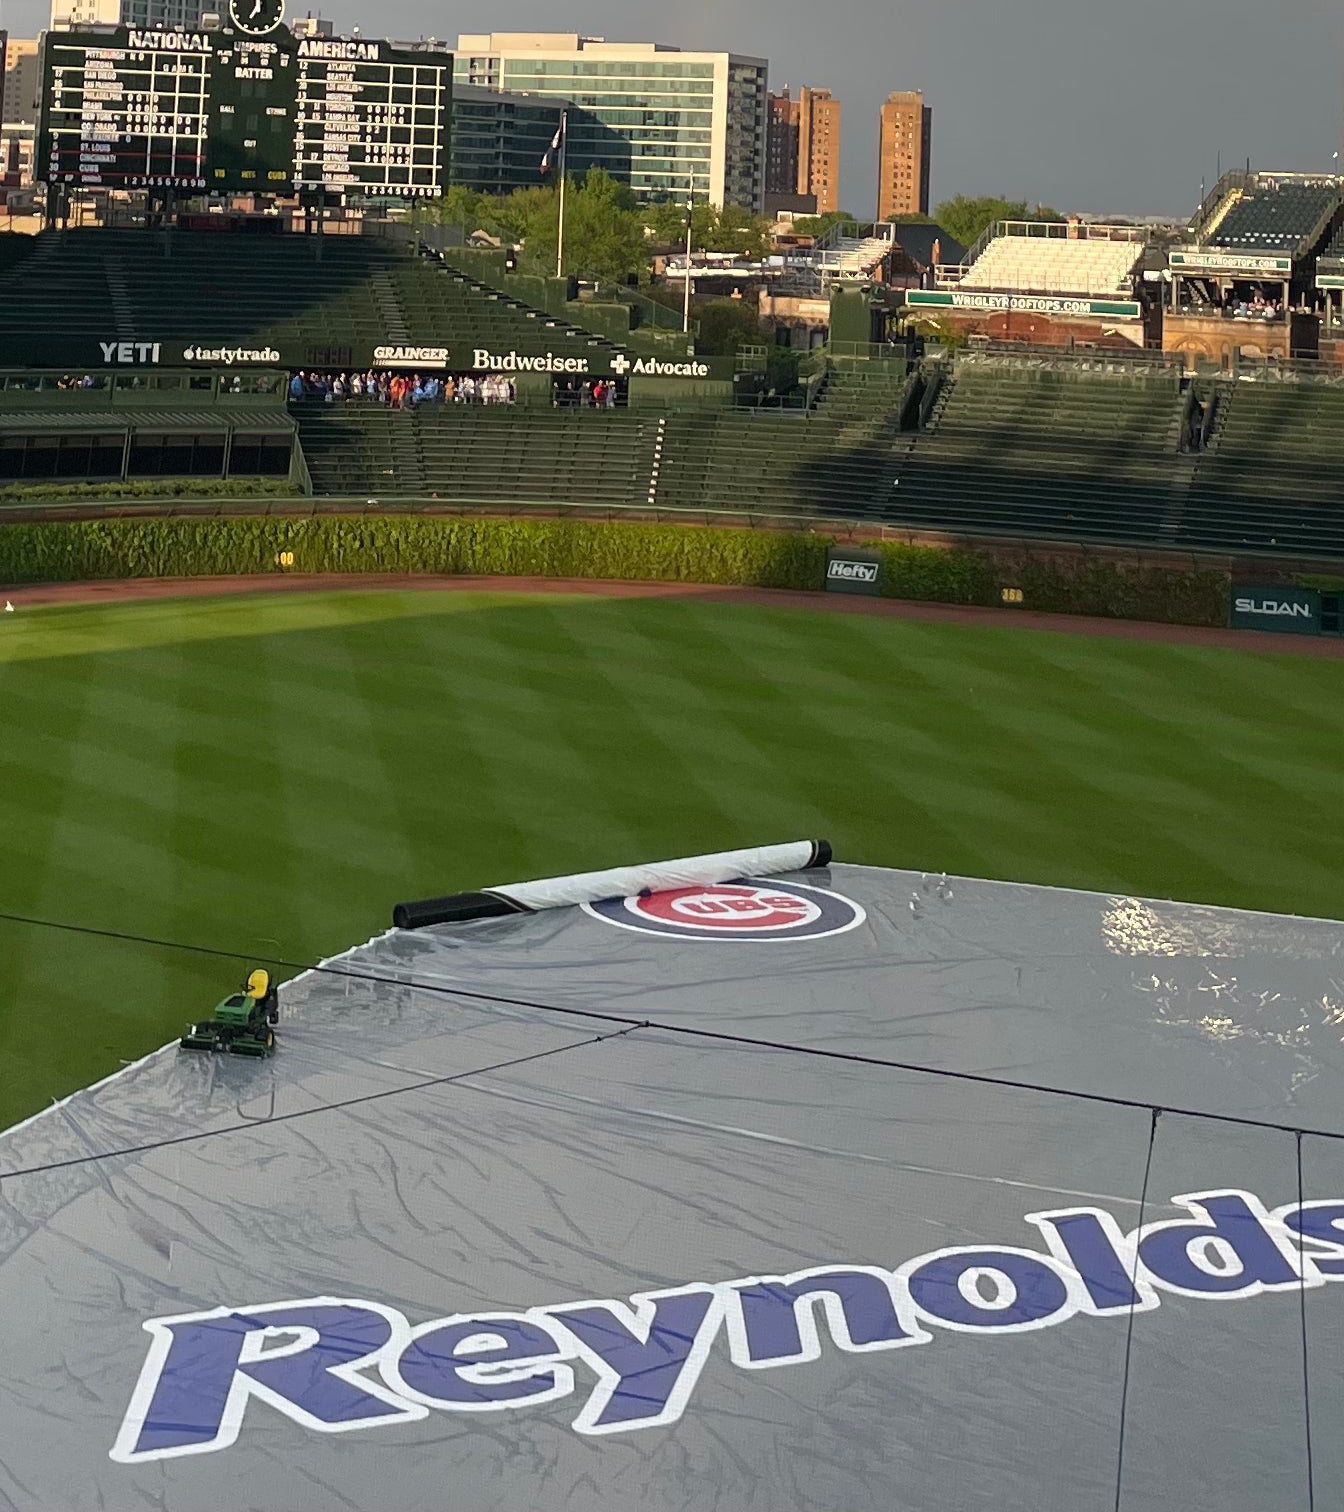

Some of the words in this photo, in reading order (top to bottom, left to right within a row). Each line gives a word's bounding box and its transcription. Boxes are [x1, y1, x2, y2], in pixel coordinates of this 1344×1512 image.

[128, 31, 213, 51] NATIONAL
[234, 41, 278, 54] UMPIRES
[297, 40, 379, 60] AMERICAN
[235, 67, 273, 80] BATTER
[952, 294, 1091, 313] WRIGLEYROOFTOPS.COM
[99, 342, 160, 363] YETI
[195, 345, 280, 365] tastytrade
[374, 346, 448, 361] GRAINGER
[473, 349, 586, 373] Budweiser
[632, 358, 707, 376] Advocate
[831, 563, 874, 580] Hefty
[1236, 598, 1312, 617] SLOAN
